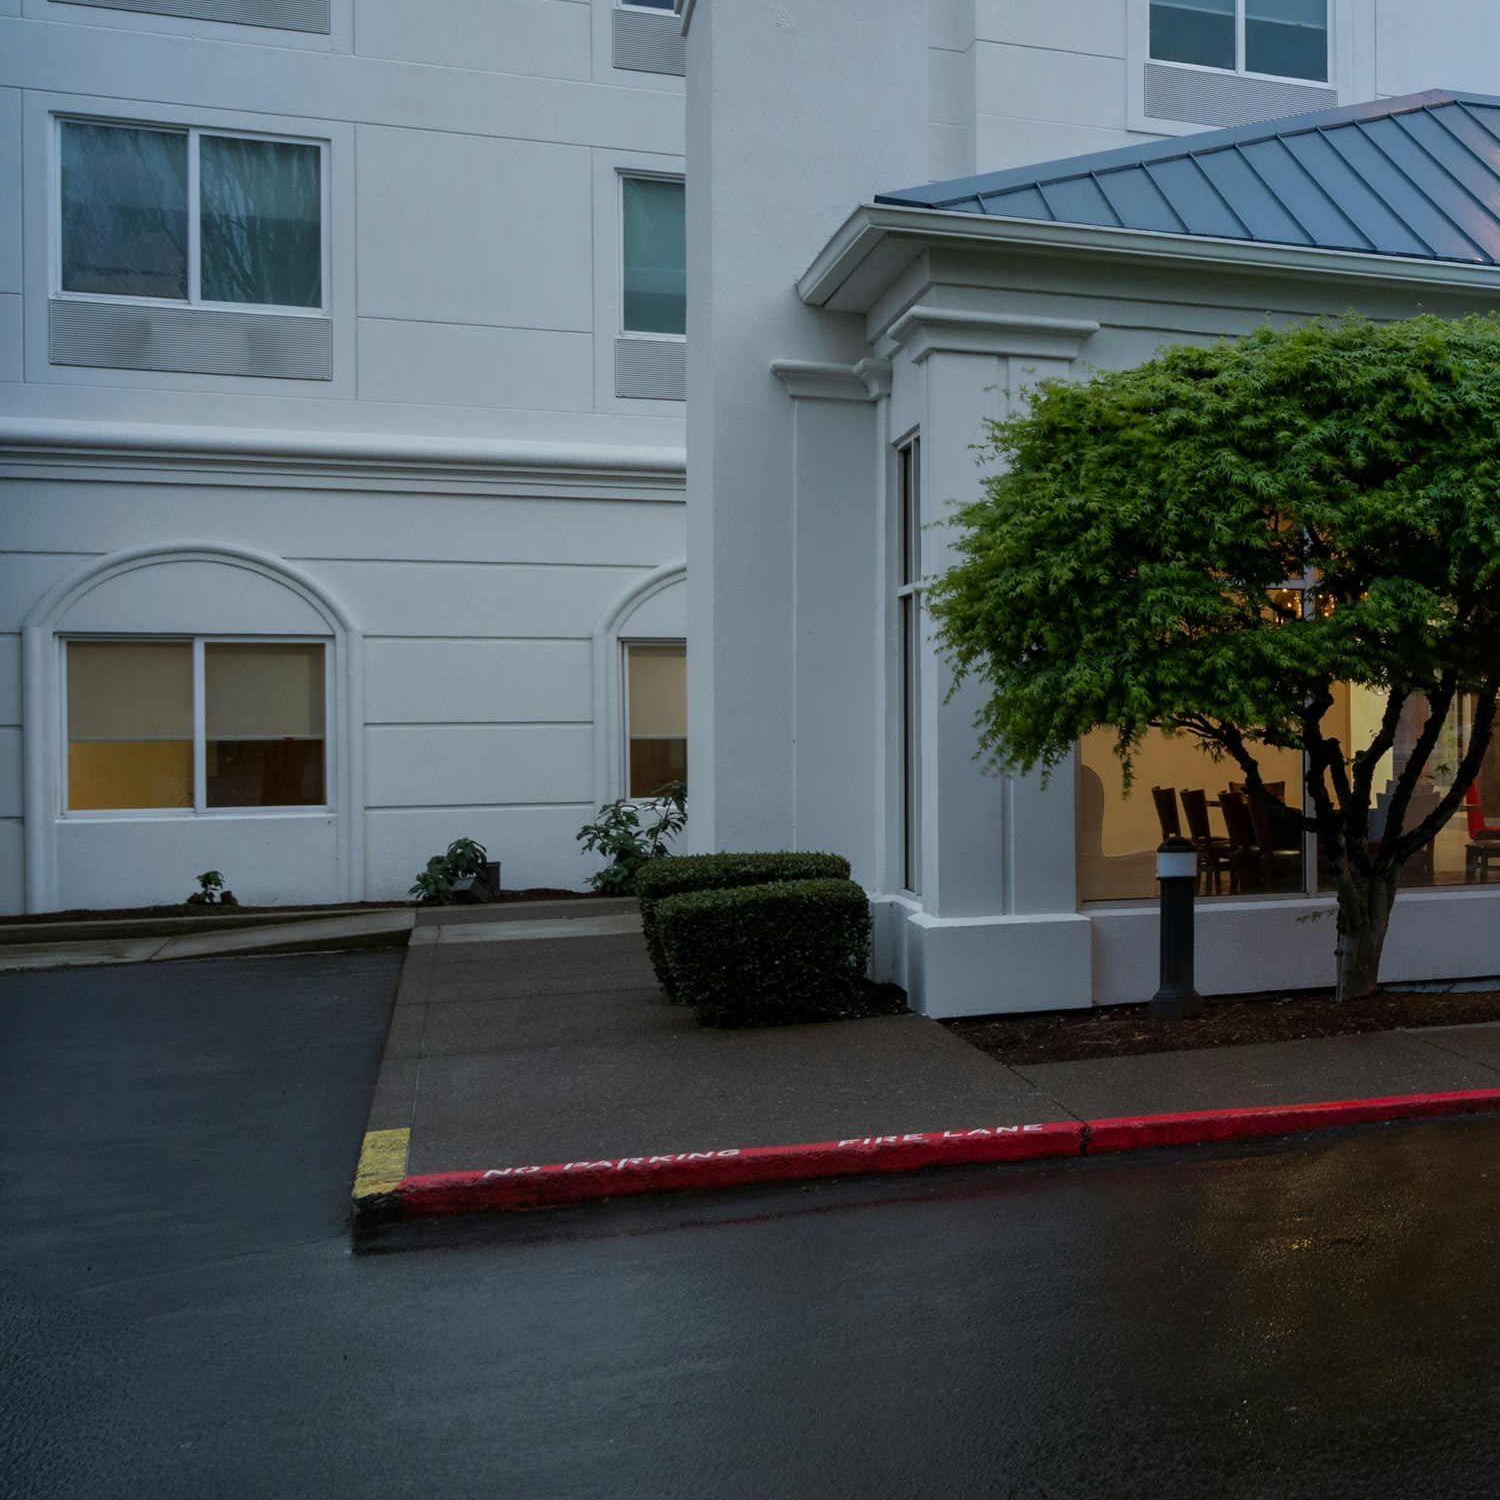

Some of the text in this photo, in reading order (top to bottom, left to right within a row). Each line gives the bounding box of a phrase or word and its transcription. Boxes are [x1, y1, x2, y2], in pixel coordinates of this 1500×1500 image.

[483, 1123, 1044, 1178] NO PARKING FIRE LANE
